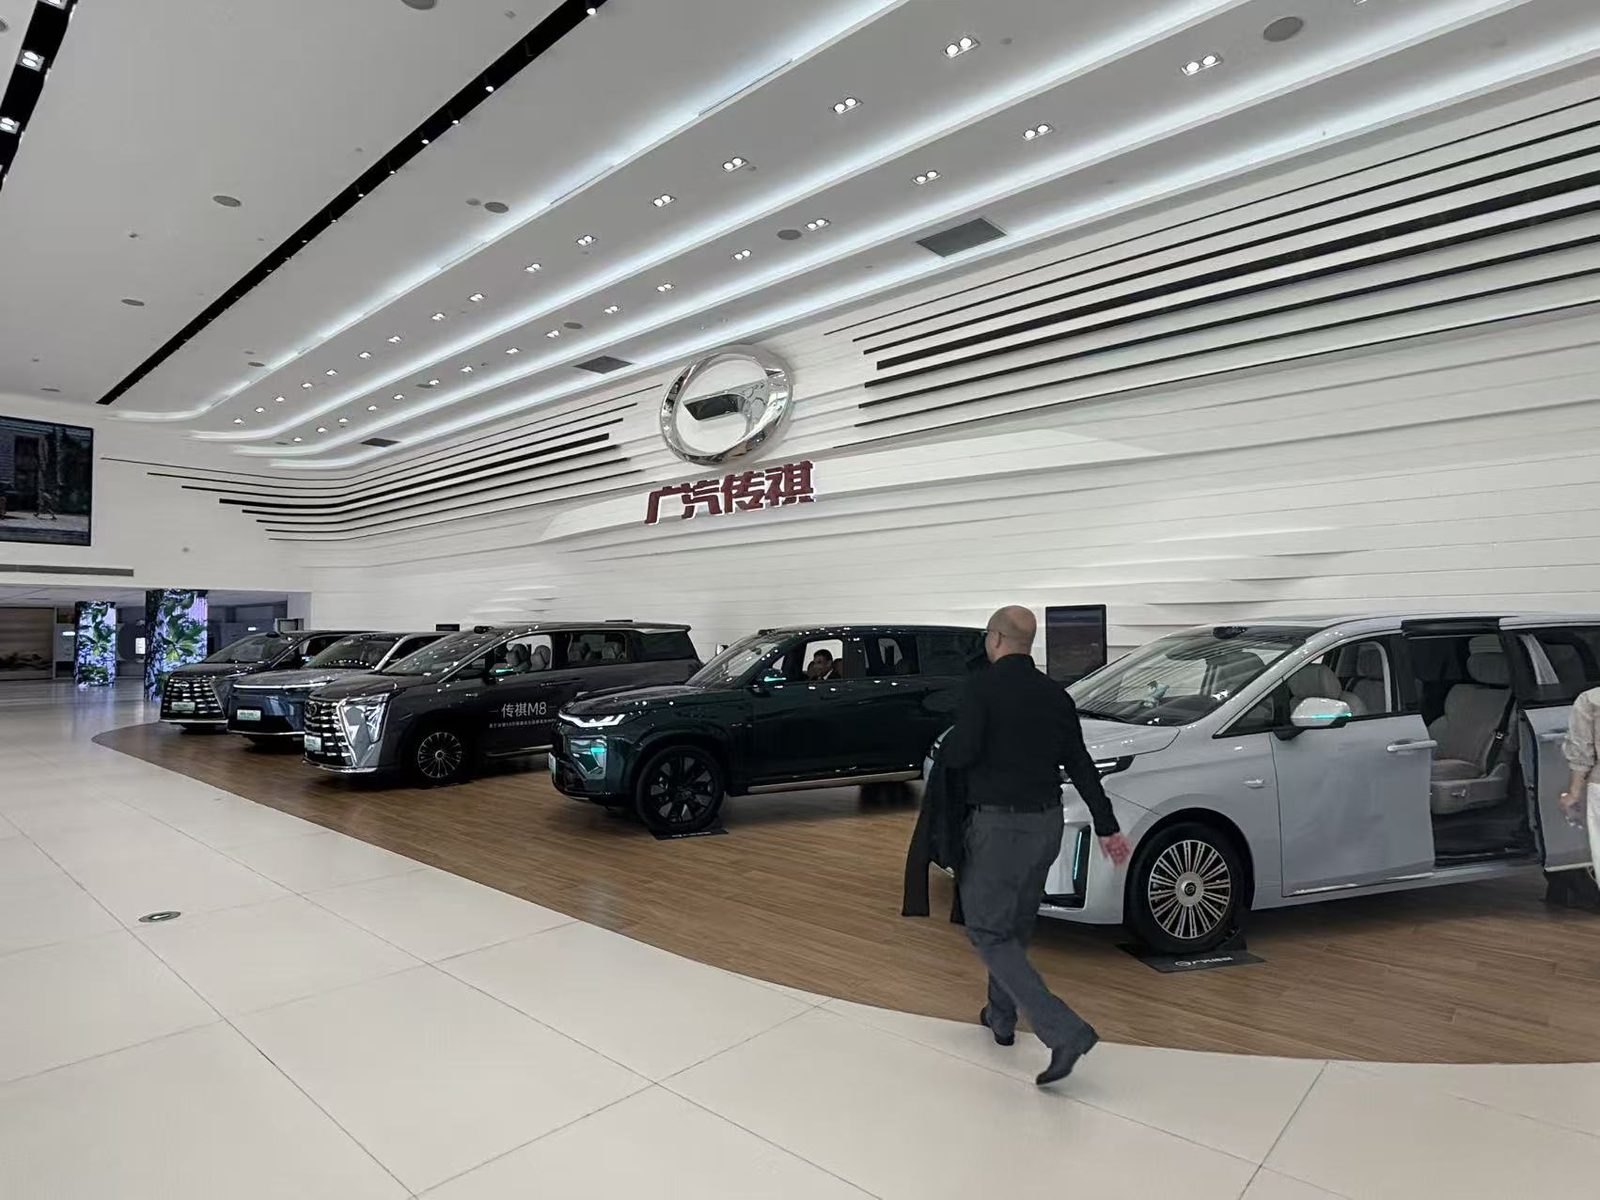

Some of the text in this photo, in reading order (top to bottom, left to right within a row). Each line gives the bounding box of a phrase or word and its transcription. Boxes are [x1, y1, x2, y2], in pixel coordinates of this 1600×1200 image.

[644, 460, 816, 524] 广汽传祺
[501, 701, 547, 718] 传祺M8
